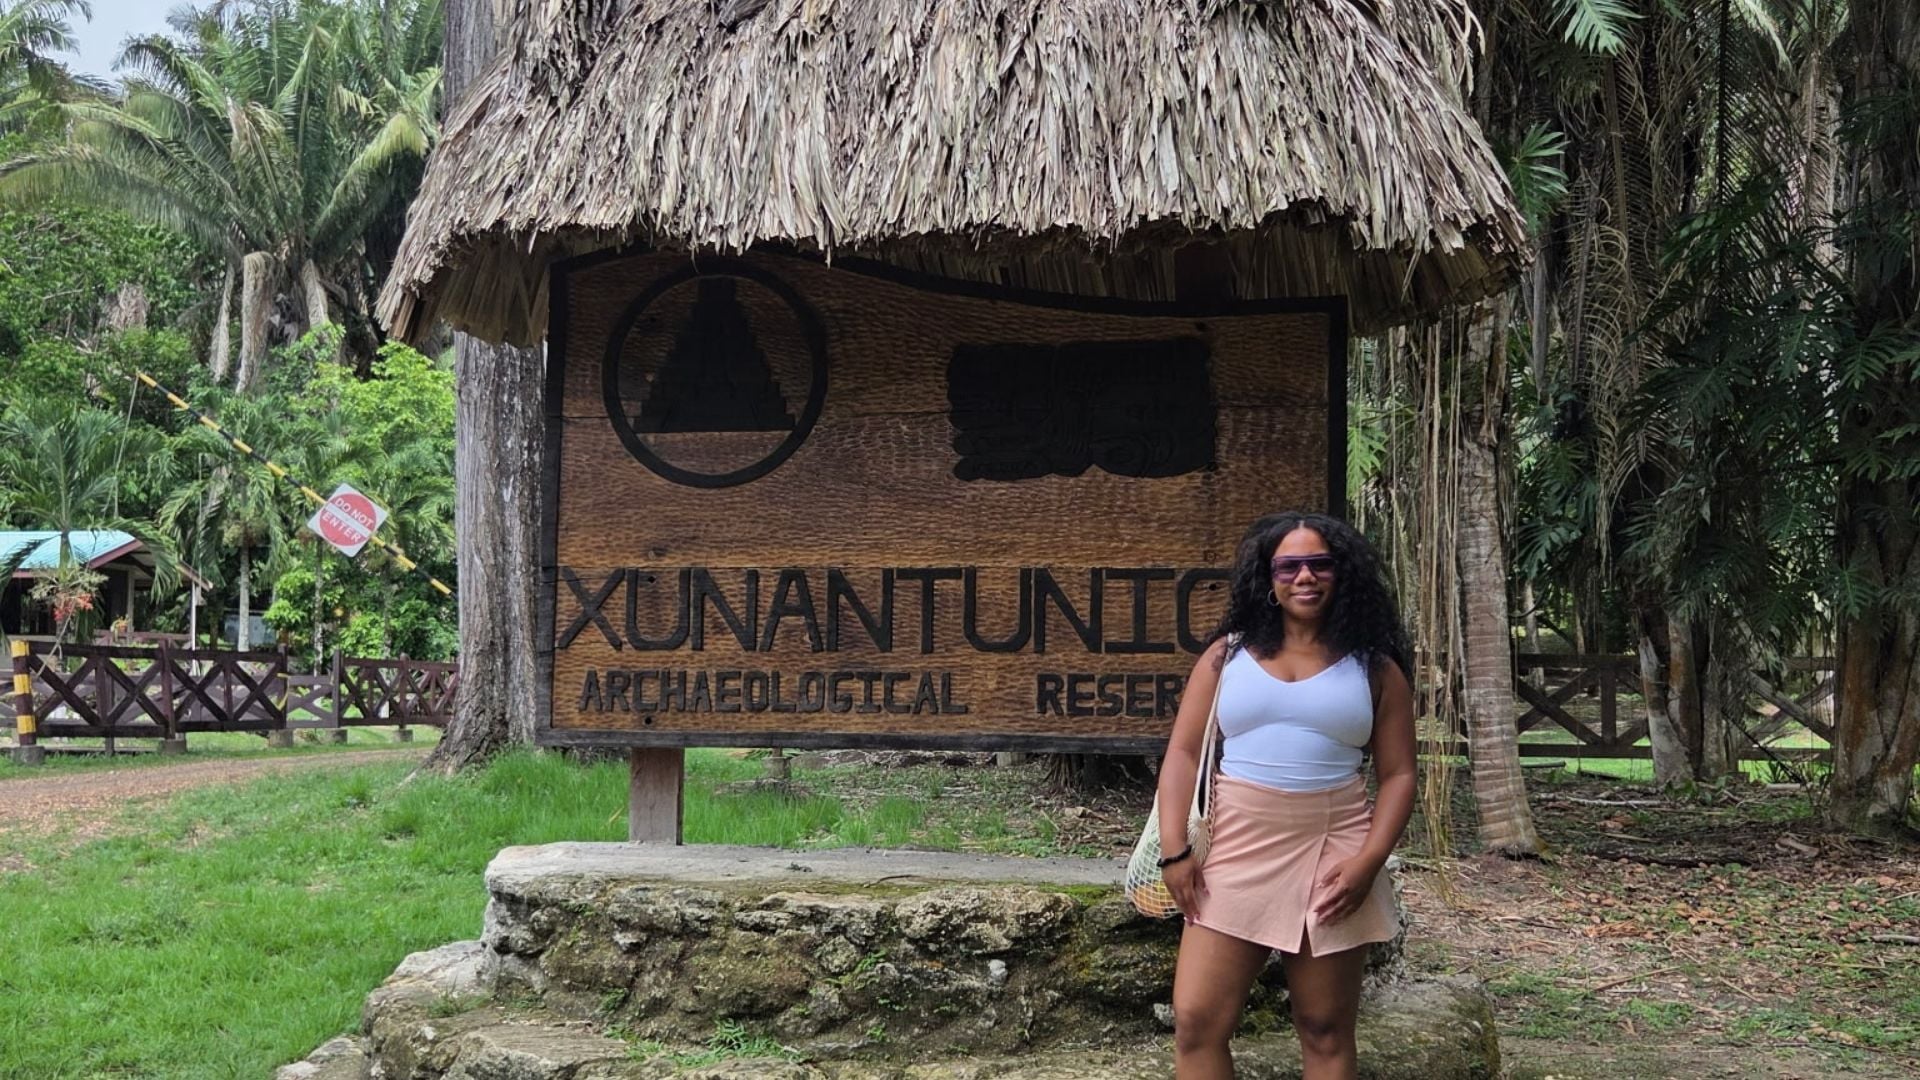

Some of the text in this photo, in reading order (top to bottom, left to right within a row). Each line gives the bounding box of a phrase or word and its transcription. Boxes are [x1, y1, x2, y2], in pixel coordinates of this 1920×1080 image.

[322, 511, 361, 542] ENTER
[335, 498, 374, 527] DO NOT
[557, 567, 1234, 653] XUNANTUNIC
[579, 669, 1188, 717] ARCHAEOLOGICAL RESER
